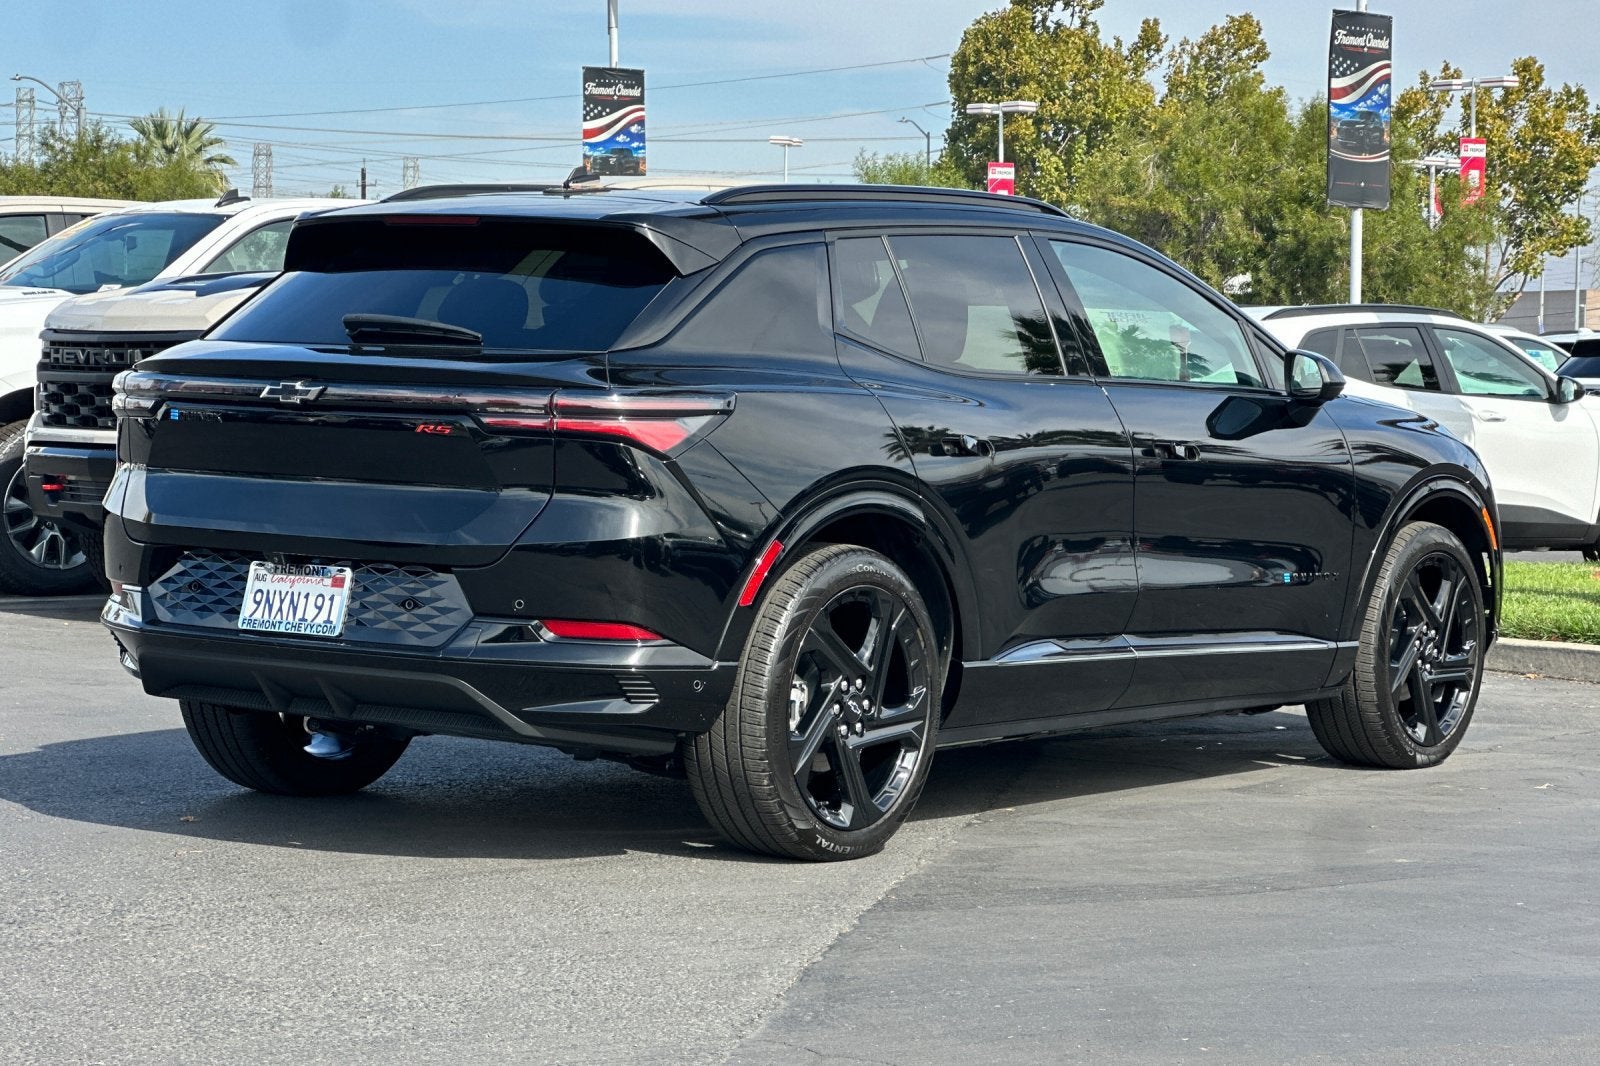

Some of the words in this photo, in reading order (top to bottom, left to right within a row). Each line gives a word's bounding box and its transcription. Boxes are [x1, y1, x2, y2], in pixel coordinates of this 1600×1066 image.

[1334, 29, 1366, 46] Fremont
[584, 82, 615, 95] Fremont
[415, 424, 452, 435] RS
[254, 572, 268, 582] AUG
[274, 564, 327, 576] FREMONT
[270, 573, 330, 589] California
[249, 588, 336, 625] 9NXN191
[241, 618, 283, 631] FREMONT
[284, 621, 337, 636] CHEVY.COM
